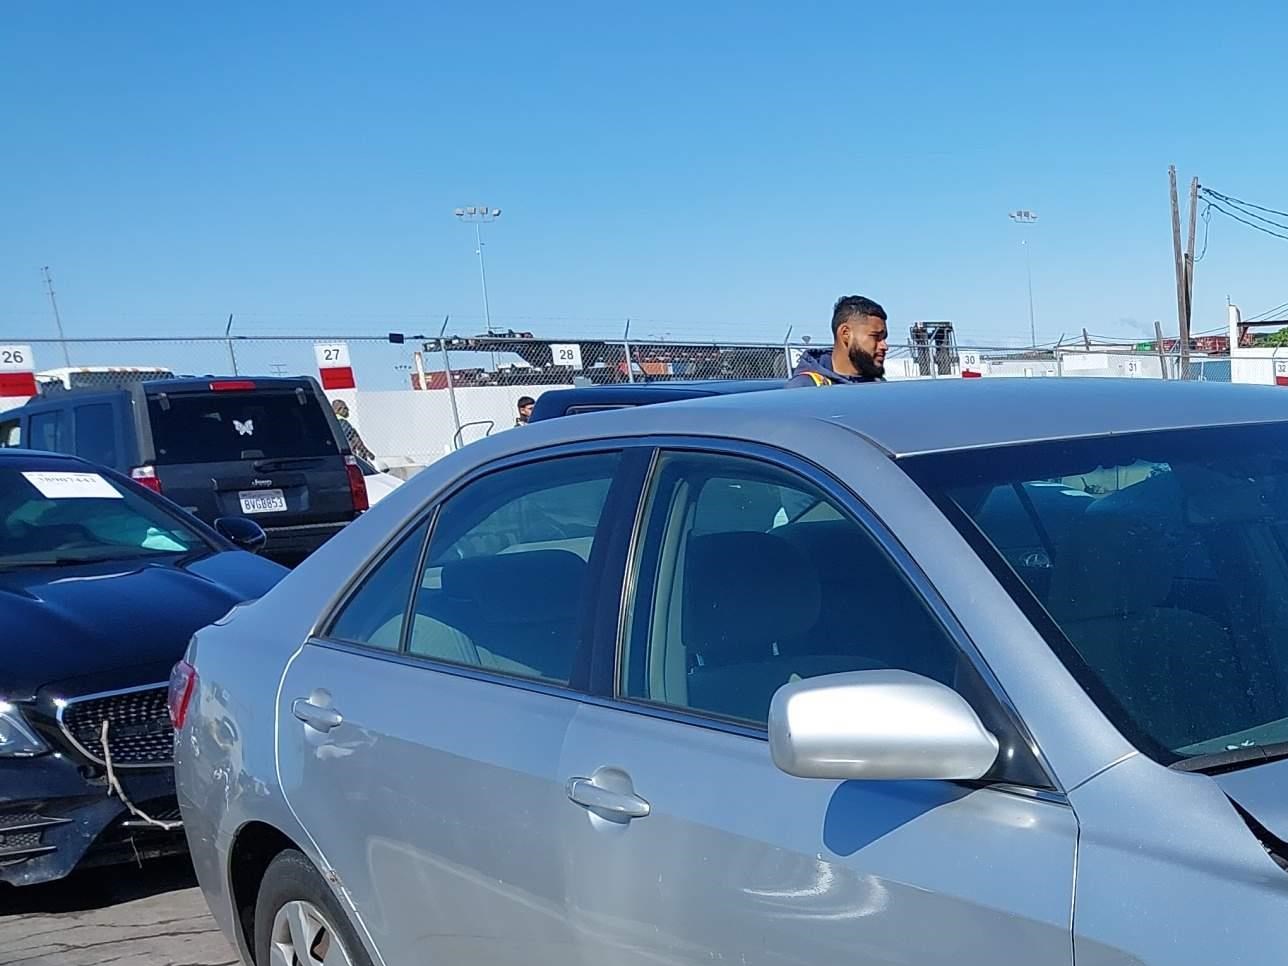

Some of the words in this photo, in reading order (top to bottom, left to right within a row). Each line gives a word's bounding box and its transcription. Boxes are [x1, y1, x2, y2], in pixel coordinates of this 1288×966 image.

[2, 350, 24, 364] 26
[323, 348, 340, 361] 27
[559, 349, 574, 360] 28
[964, 355, 976, 365] 30
[1128, 362, 1137, 372] 31
[1277, 364, 1287, 373] 32
